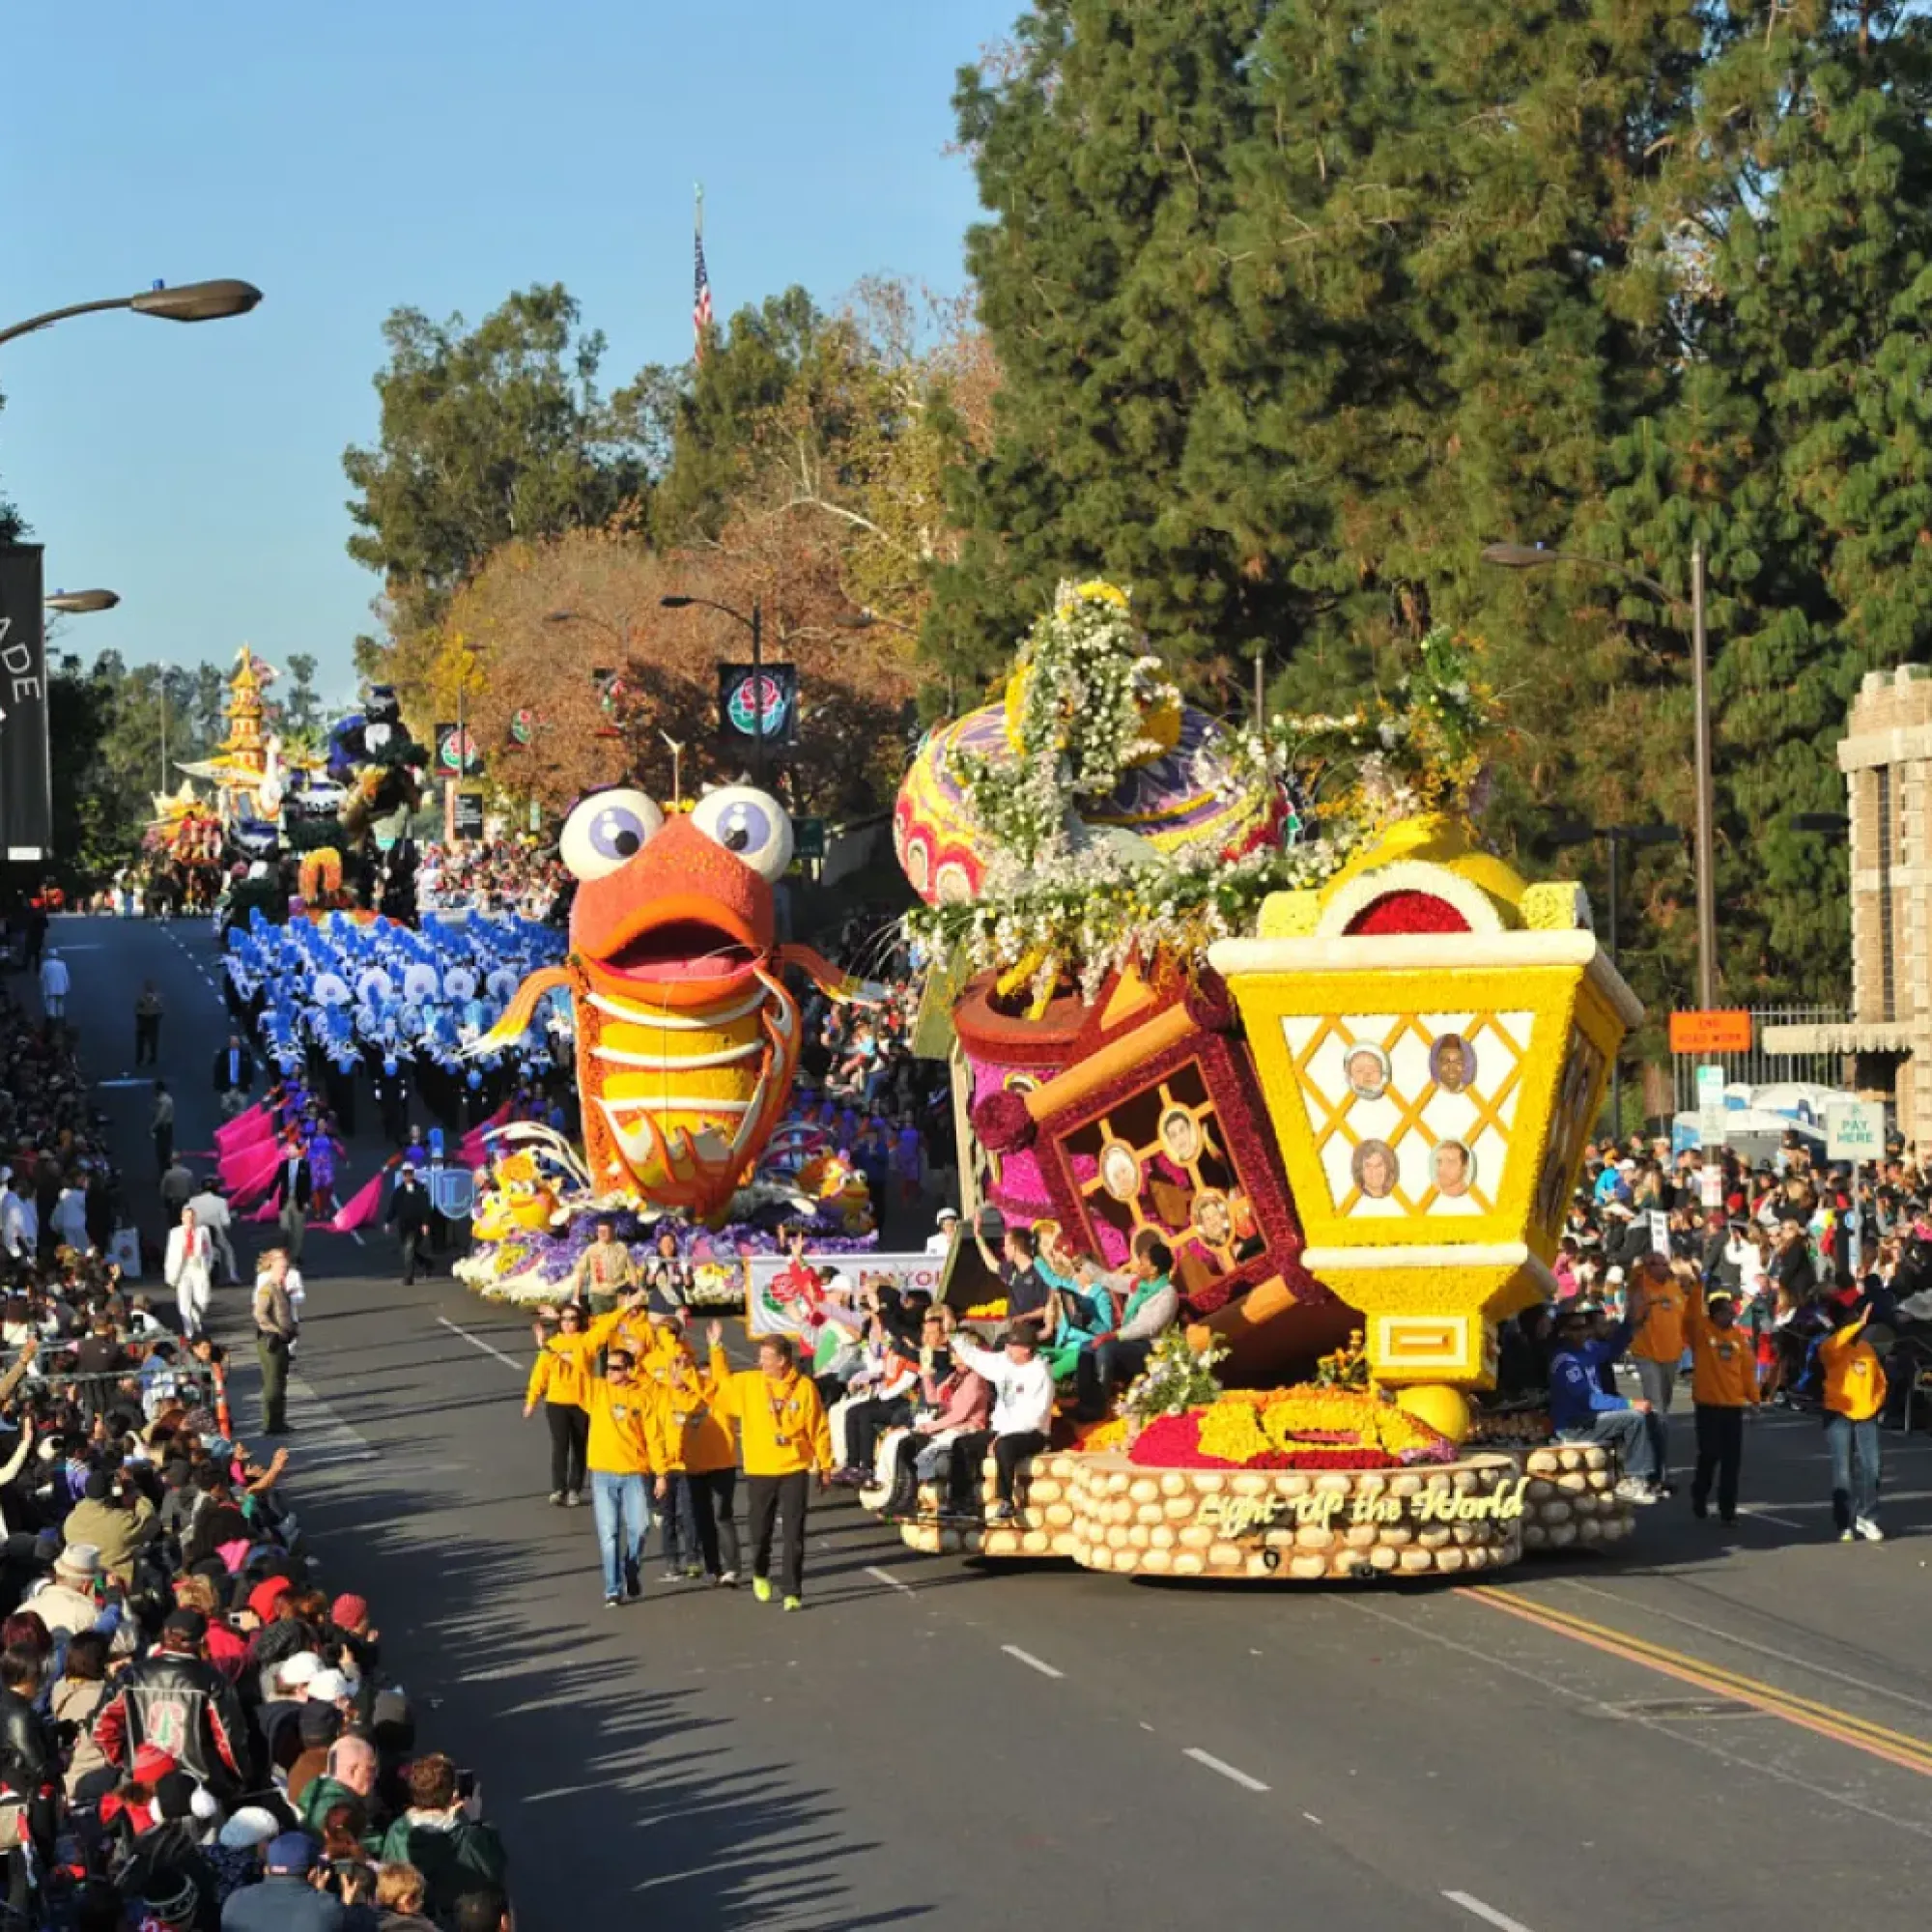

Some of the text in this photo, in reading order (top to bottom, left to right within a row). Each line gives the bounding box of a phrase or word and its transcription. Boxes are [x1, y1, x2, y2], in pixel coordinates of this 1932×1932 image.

[1841, 1119, 1869, 1131] PAY
[1836, 1131, 1874, 1144] HERE
[1350, 1482, 1402, 1522] the
[1411, 1476, 1532, 1521] World
